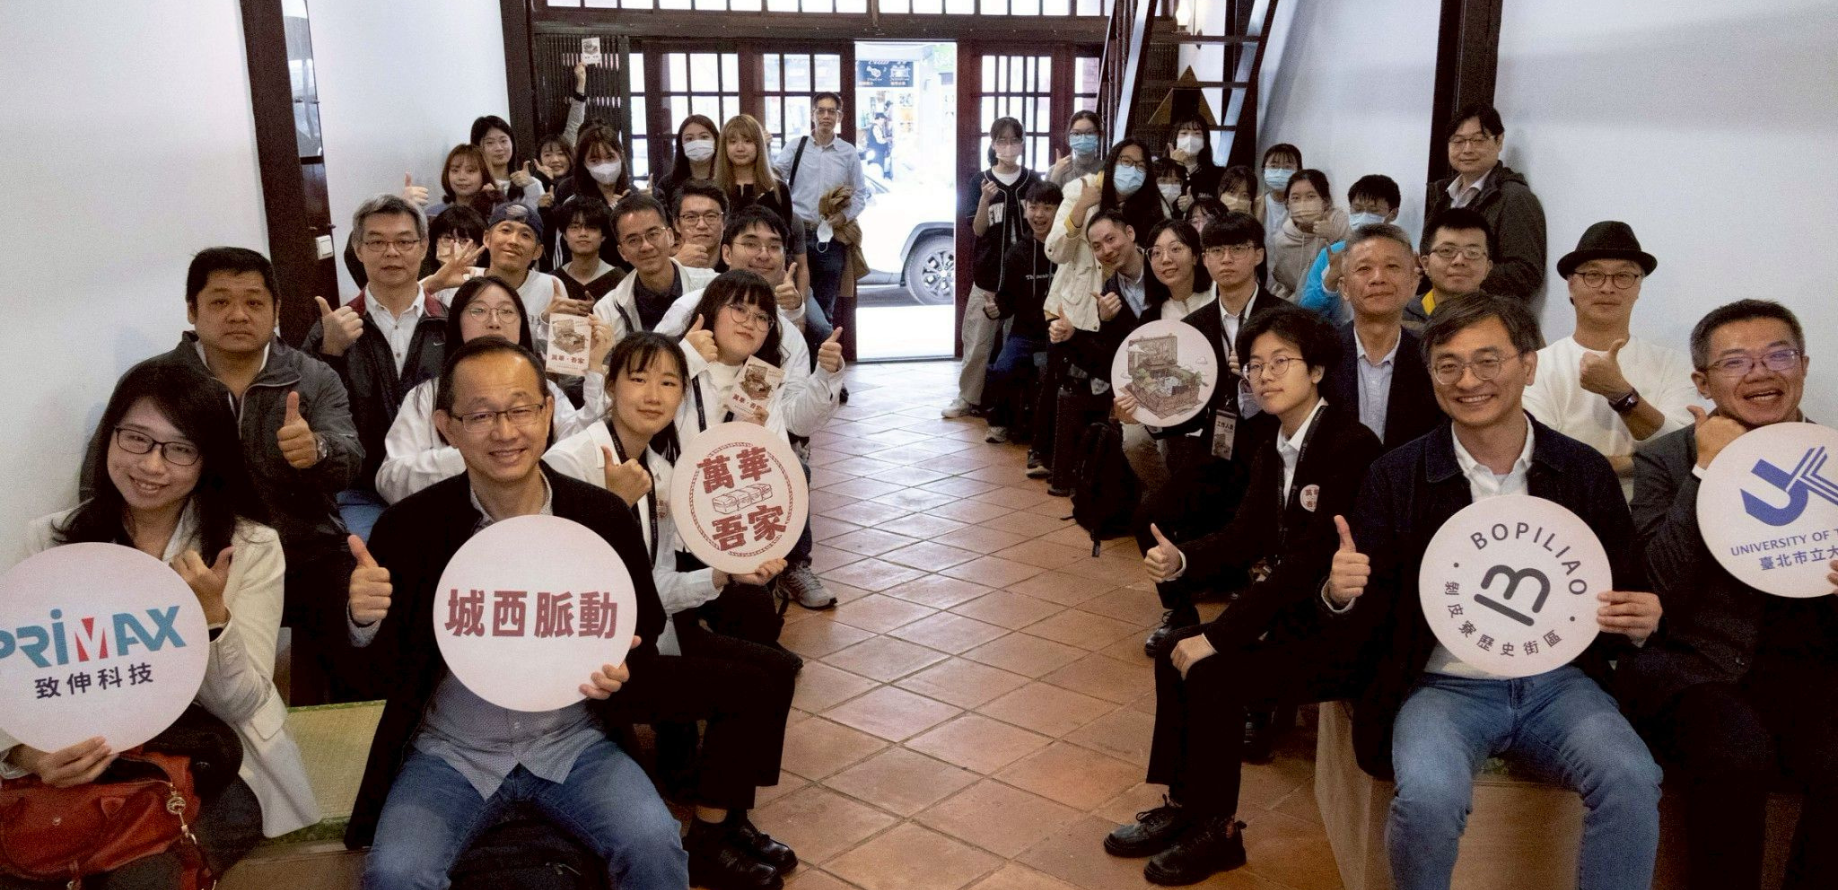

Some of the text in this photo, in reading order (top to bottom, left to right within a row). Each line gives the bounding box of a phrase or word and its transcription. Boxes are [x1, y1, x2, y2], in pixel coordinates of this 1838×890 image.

[696, 446, 772, 494] 萬華
[711, 504, 787, 551] 吾家
[1730, 534, 1807, 557] UNIVERSITY
[1812, 530, 1830, 542] OF
[1470, 522, 1587, 595] BOPILIAO
[1759, 545, 1838, 571] 臺北市立大
[444, 589, 618, 639] 城西脈動
[35, 662, 154, 699] 致伸科技
